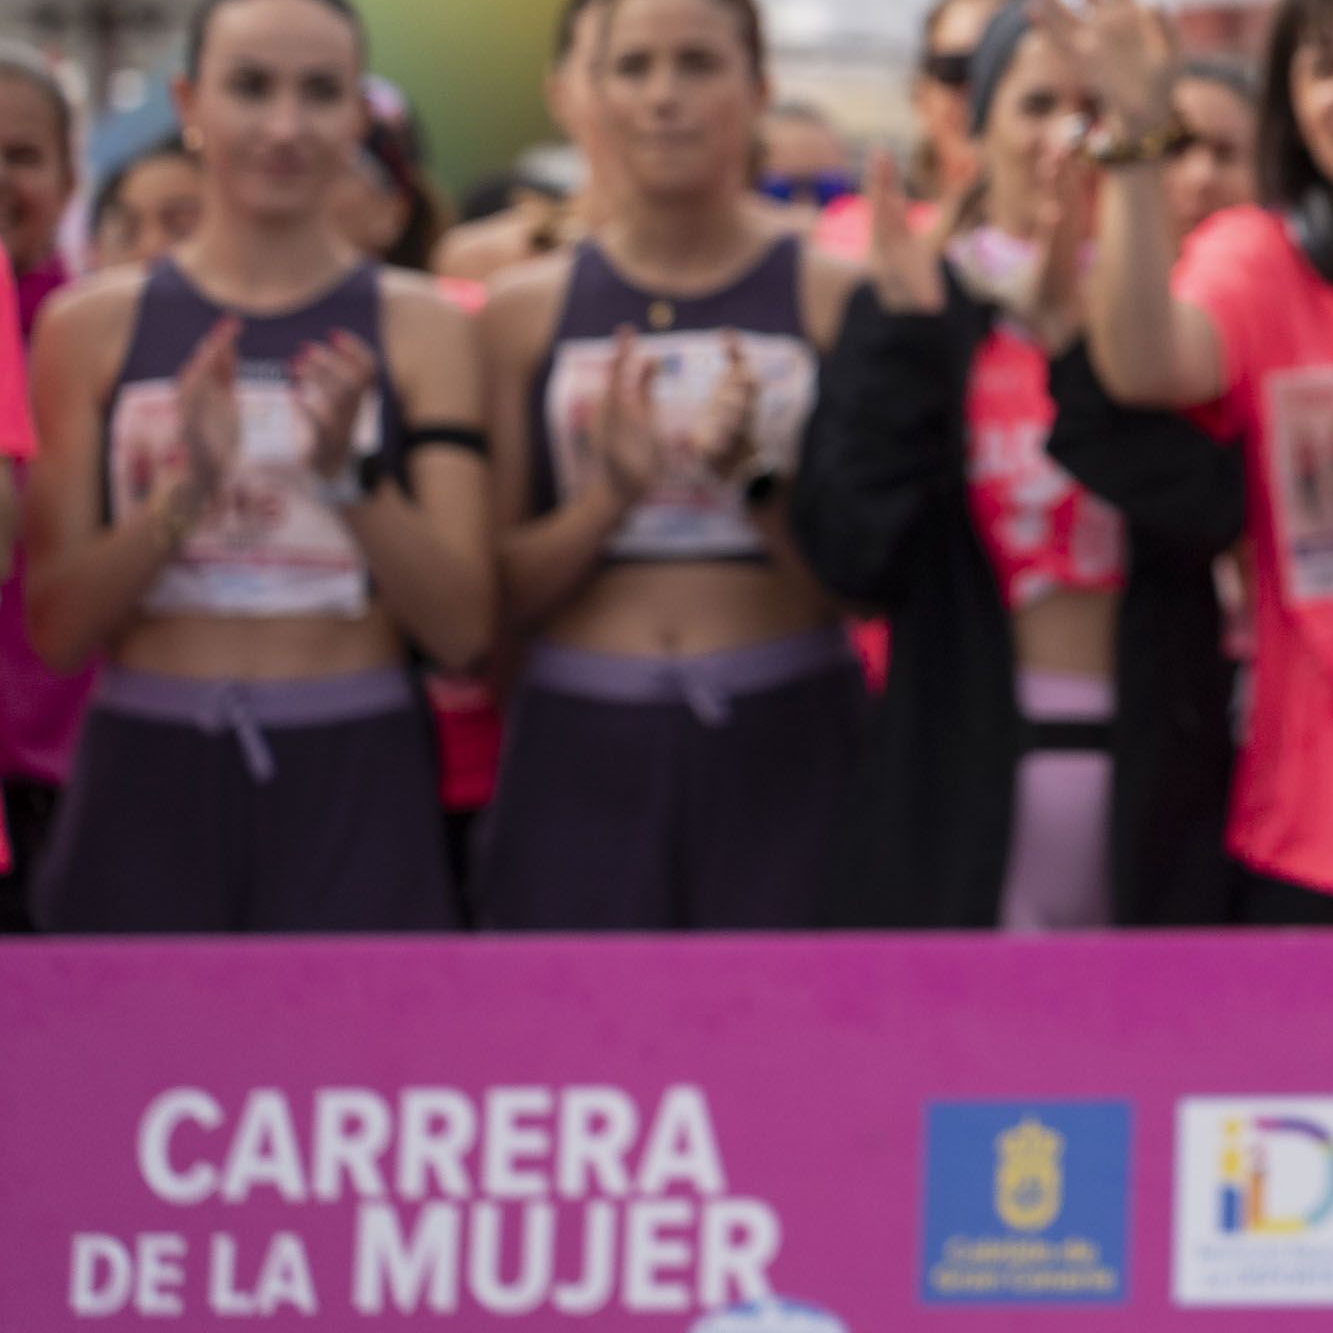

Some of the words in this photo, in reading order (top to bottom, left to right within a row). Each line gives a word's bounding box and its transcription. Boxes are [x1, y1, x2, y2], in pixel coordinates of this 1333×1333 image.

[138, 1084, 725, 1204] CARRERA
[70, 1234, 187, 1316] DE
[208, 1234, 319, 1316] LA
[354, 1199, 780, 1314] MUJER
